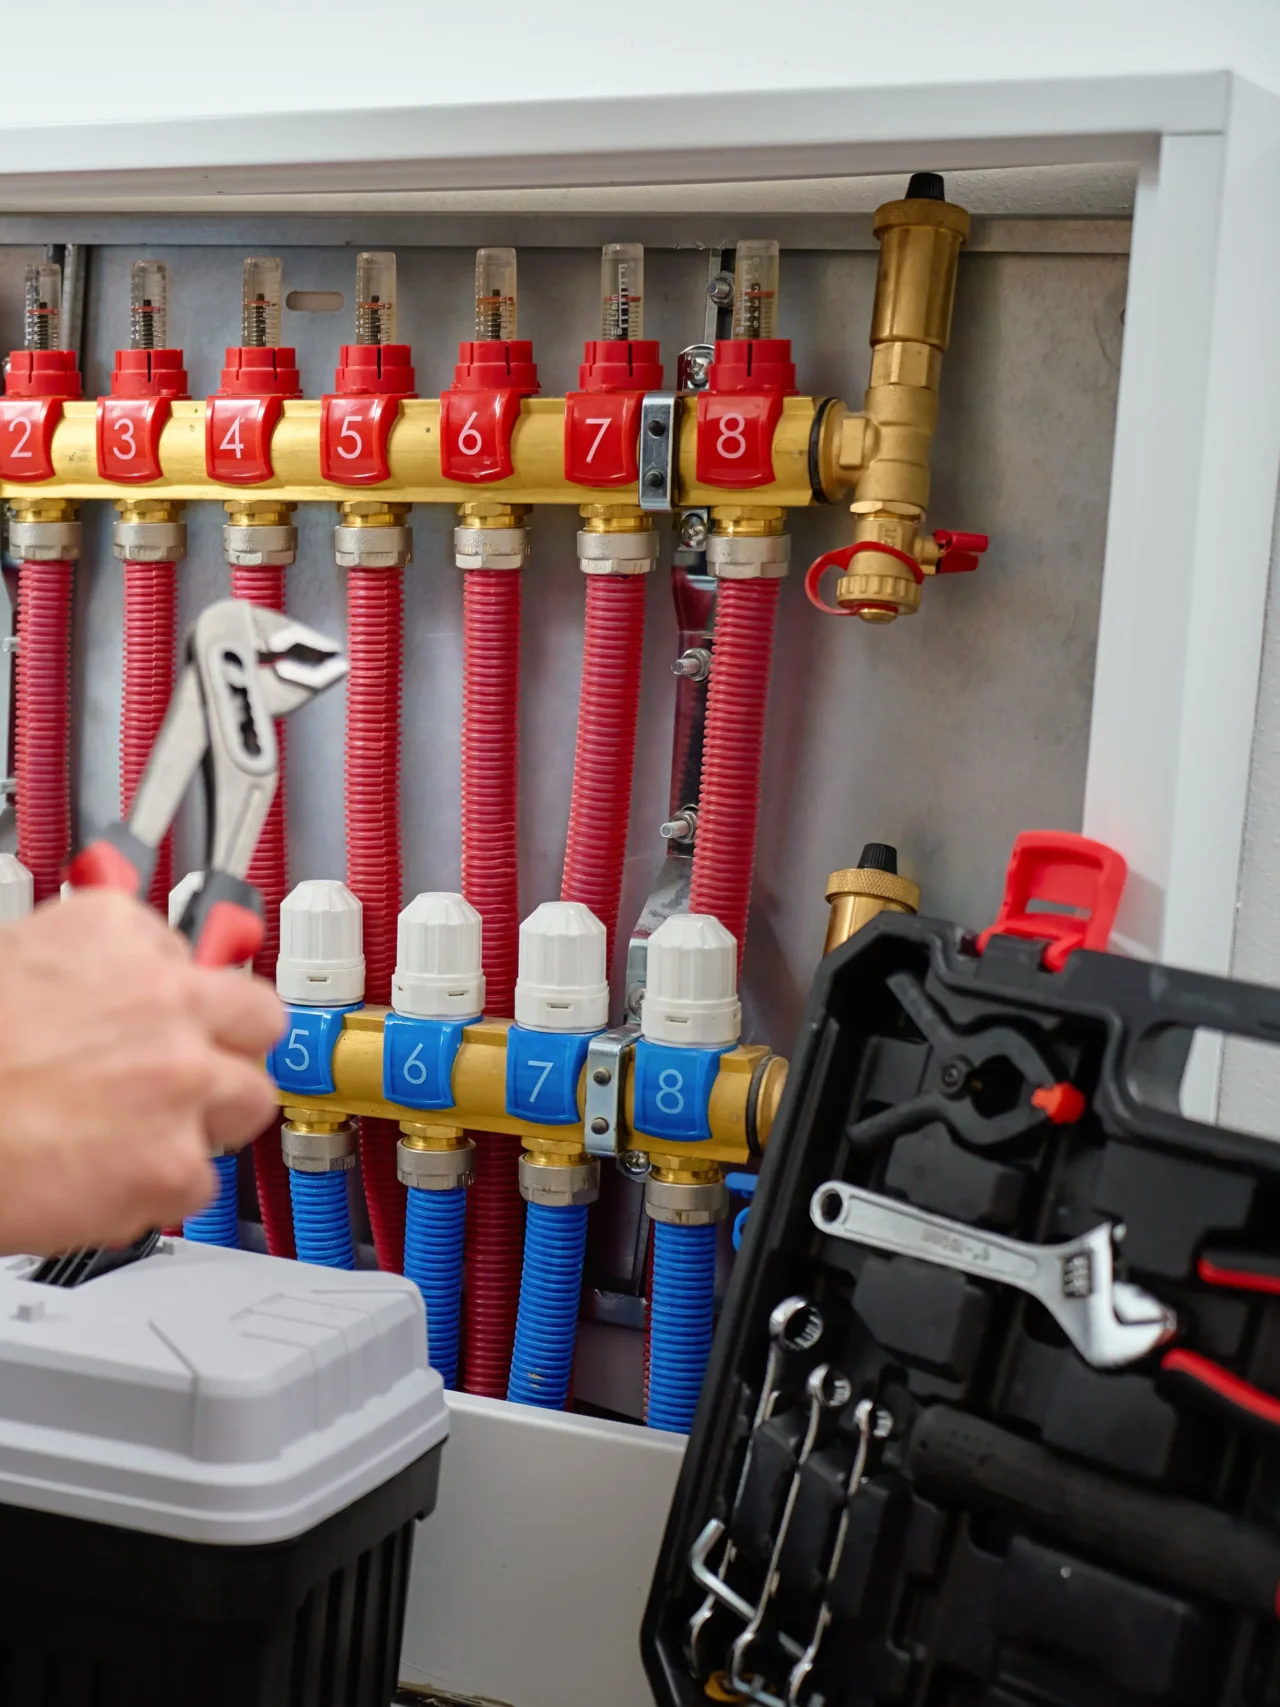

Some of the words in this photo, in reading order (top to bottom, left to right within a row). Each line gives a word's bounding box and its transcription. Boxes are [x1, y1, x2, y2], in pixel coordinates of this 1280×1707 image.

[8, 416, 33, 458] 2
[112, 418, 136, 461] 3
[220, 416, 244, 459] 4
[336, 415, 363, 460] 5
[457, 411, 483, 456] 6
[585, 418, 612, 464] 7
[716, 412, 746, 459] 8
[284, 1028, 310, 1071] 5
[403, 1043, 427, 1085] 6
[527, 1060, 554, 1103] 7
[655, 1068, 684, 1114] 8
